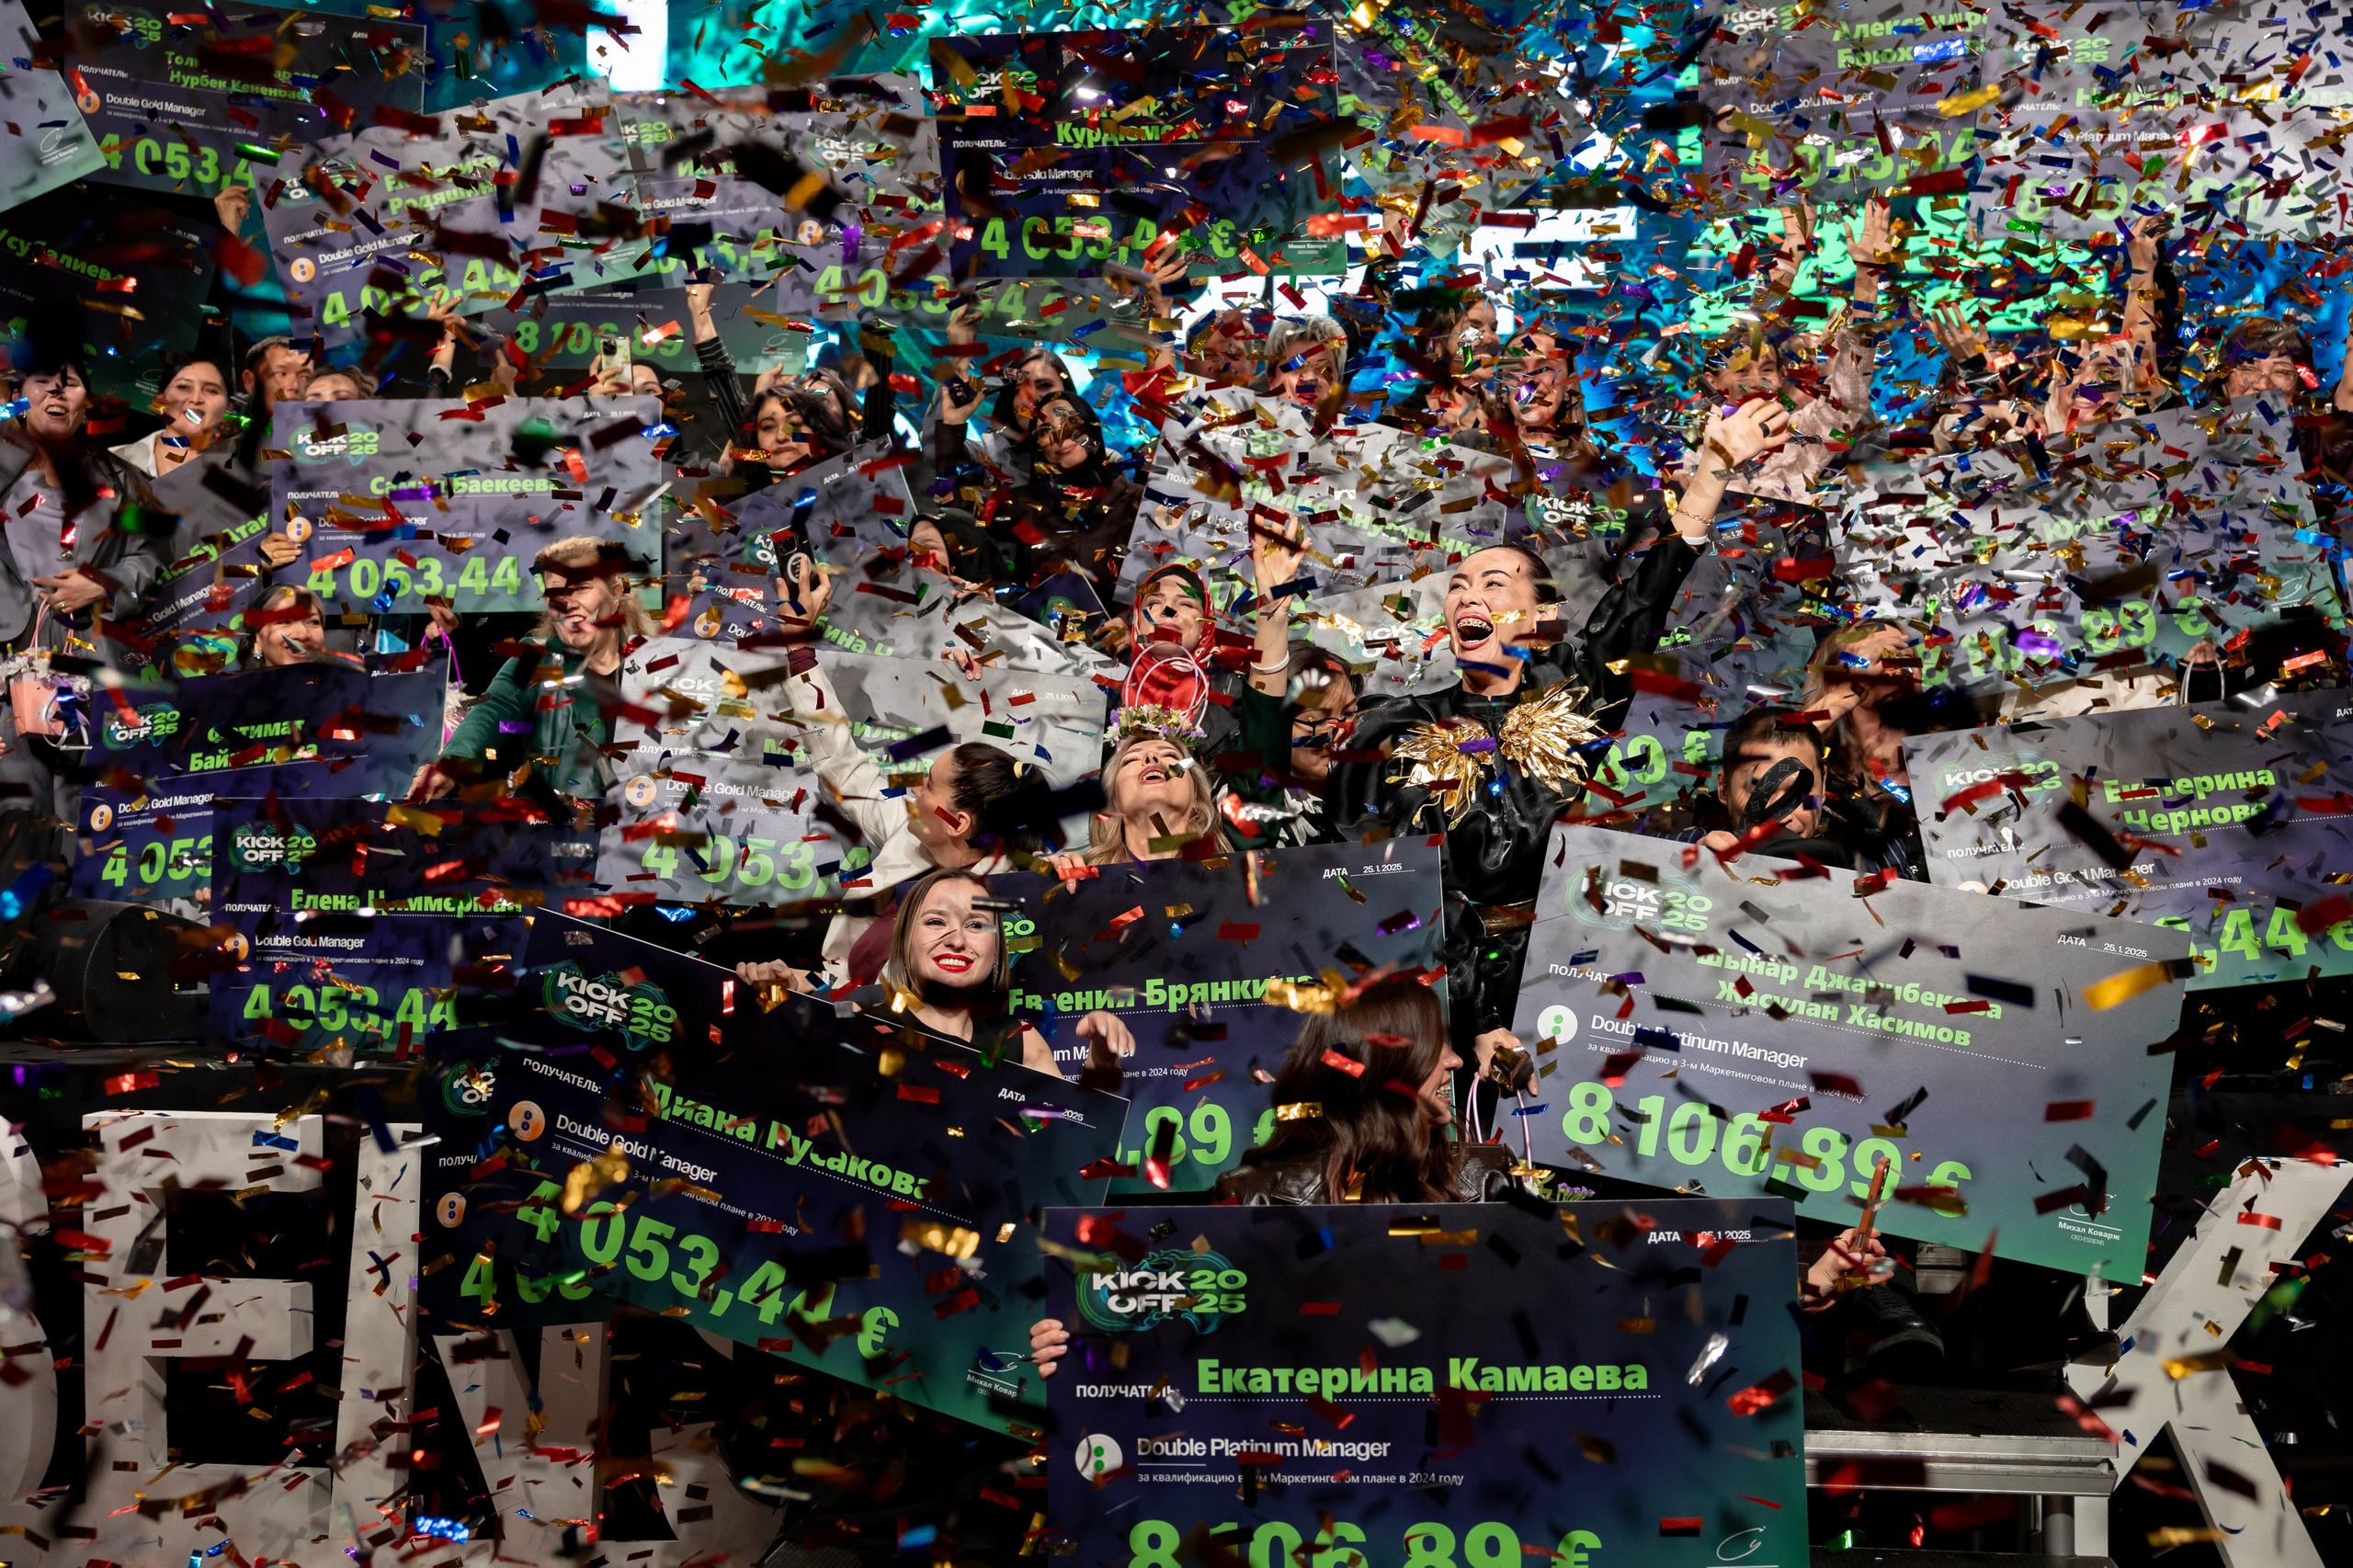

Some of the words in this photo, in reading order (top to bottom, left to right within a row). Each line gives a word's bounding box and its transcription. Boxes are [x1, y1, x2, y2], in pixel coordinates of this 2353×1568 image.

[134, 17, 162, 31] 20
[1723, 6, 1778, 25] KICK
[2075, 38, 2111, 51] 20
[2074, 50, 2109, 63] 25
[77, 64, 129, 79] ПОЛУЧАТЕЛЬ:
[169, 69, 228, 89] Нурбек
[107, 94, 140, 107] Double
[141, 99, 164, 111] Gold
[165, 101, 207, 118] Manager
[639, 120, 667, 133] 20
[99, 132, 123, 169] 4
[814, 138, 864, 153] KICK
[953, 139, 1007, 150] ПОЛУЧАТЕЛЬ:
[1048, 168, 1094, 183] Manager
[980, 216, 1010, 260] 4
[1208, 218, 1237, 259] €
[318, 247, 353, 265] Double
[354, 240, 378, 256] Gold
[322, 290, 351, 329] 4
[515, 321, 540, 353] 8
[348, 431, 380, 444] 20
[305, 443, 347, 458] OFF
[348, 443, 379, 457] 25
[305, 558, 337, 599] 4
[349, 556, 522, 600] 053,44
[152, 604, 177, 622] Gold
[2174, 595, 2209, 637] €
[654, 676, 714, 691] KICK
[153, 710, 181, 725] 20
[115, 725, 153, 742] OFF
[153, 722, 179, 738] 25
[714, 782, 745, 797] Gold
[151, 796, 173, 811] Gold
[173, 791, 215, 808] Manager
[236, 835, 285, 848] KICK
[287, 835, 317, 849] 20
[102, 846, 129, 887] 4
[244, 849, 284, 862] OFF
[1322, 866, 1349, 881] ДАТА
[1362, 861, 1404, 875] 25.1.2025
[2084, 892, 2101, 901] 3-м
[2168, 880, 2194, 893] плане
[2201, 877, 2223, 889] 2024
[2223, 876, 2244, 890] году
[291, 889, 361, 912] Елена
[1663, 891, 1713, 914] 20
[1660, 909, 1710, 932] 25
[318, 936, 366, 950] Manager
[2056, 933, 2087, 949] ДАТА
[2102, 941, 2149, 960] 25.1.2025
[243, 984, 273, 1020] 4
[557, 971, 632, 1010] KICK
[631, 996, 678, 1024] 20
[563, 994, 628, 1026] OFF
[628, 1017, 674, 1044] 25
[1714, 978, 1840, 1022] Жасулан
[1847, 1004, 1972, 1048] Хасимов
[1730, 1040, 1809, 1070] Manager
[521, 1058, 602, 1096] ПОЛУЧАТЕЛЬ:
[1148, 1068, 1168, 1078] 2024
[1168, 1067, 1189, 1079] году
[1586, 1042, 1597, 1052] за
[1680, 1059, 1699, 1071] 3-м
[1699, 1062, 1777, 1086] Маркетинговом
[1777, 1079, 1807, 1092] плане
[997, 1085, 1027, 1105] ДАТА
[1562, 1081, 1614, 1145] 8
[555, 1113, 610, 1146] Double
[610, 1134, 649, 1159] Gold
[551, 1142, 562, 1152] за
[719, 1201, 746, 1218] плане
[1647, 1231, 1681, 1244] ДАТА
[2058, 1221, 2086, 1235] Михал
[2086, 1226, 2121, 1243] Коварж
[1092, 1270, 1186, 1290] KICK
[1190, 1269, 1248, 1290] 20
[1106, 1293, 1177, 1314] OFF
[1190, 1292, 1248, 1314] 25
[856, 1305, 901, 1360] €
[966, 1373, 993, 1390] Михал
[1198, 1358, 1434, 1403] Екатерина
[1449, 1357, 1649, 1392] Камаева
[1136, 1438, 1207, 1458] Double
[1210, 1438, 1300, 1458] Platinum
[1301, 1439, 1392, 1461] Manager
[1137, 1473, 1151, 1483] за
[1152, 1471, 1236, 1485] квалификацию
[1362, 1473, 1397, 1484] плане
[1399, 1474, 1407, 1483] в
[1407, 1472, 1437, 1484] 2024
[1438, 1475, 1465, 1486] году
[1129, 1519, 1180, 1568] 8
